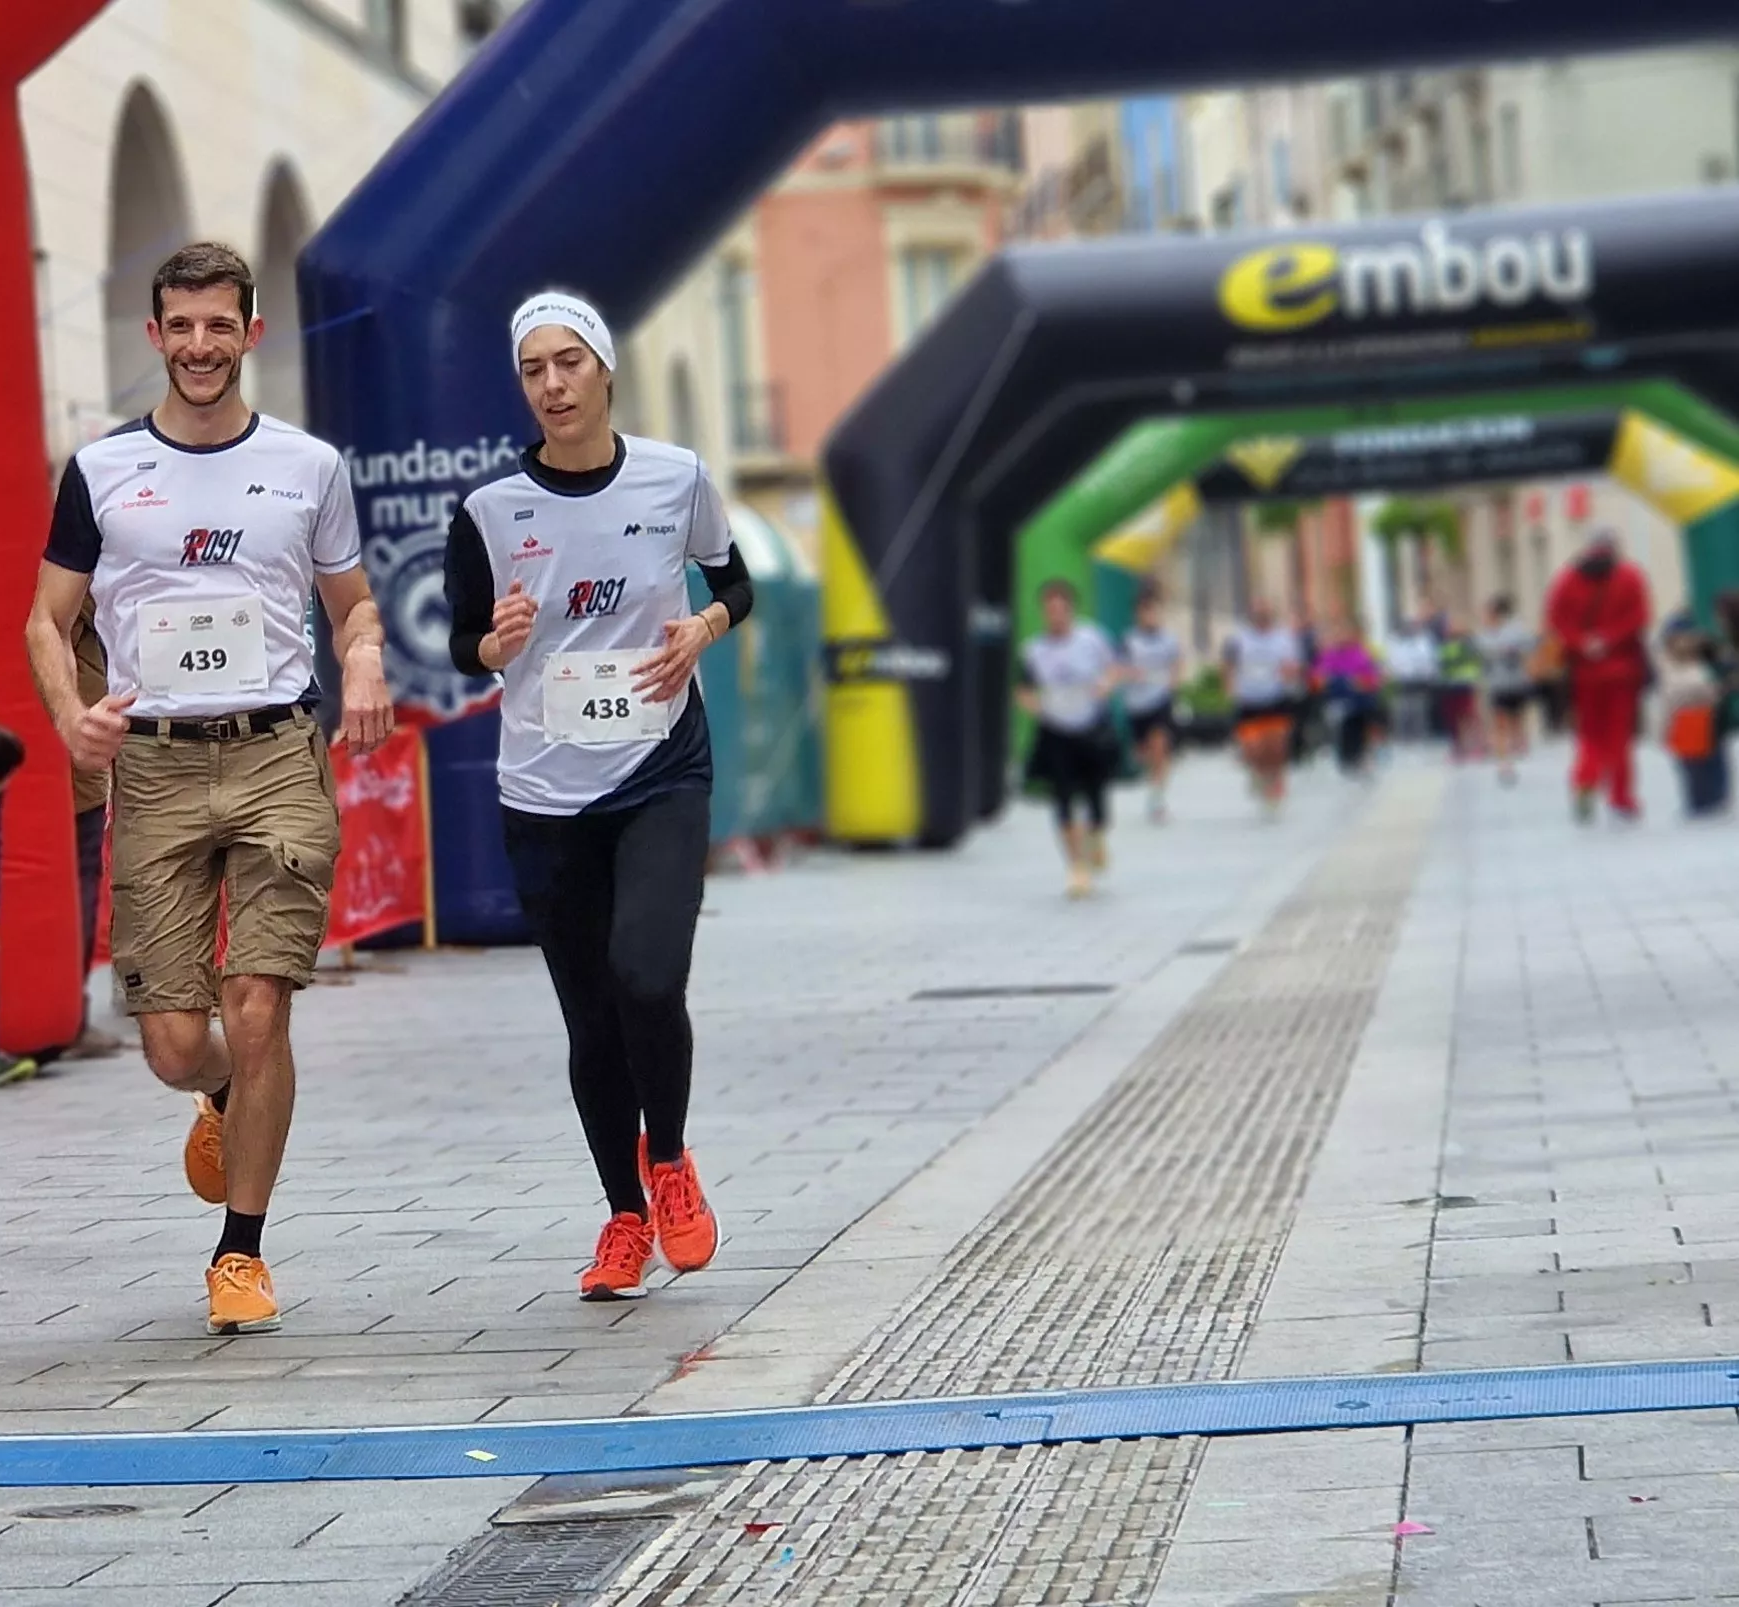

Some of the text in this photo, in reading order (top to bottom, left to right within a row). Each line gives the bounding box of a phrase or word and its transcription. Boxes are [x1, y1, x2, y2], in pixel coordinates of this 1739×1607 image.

[1218, 220, 1592, 332] embou
[344, 434, 525, 487] fundació
[371, 490, 461, 537] mup
[179, 648, 228, 672] 439
[581, 697, 631, 720] 438
